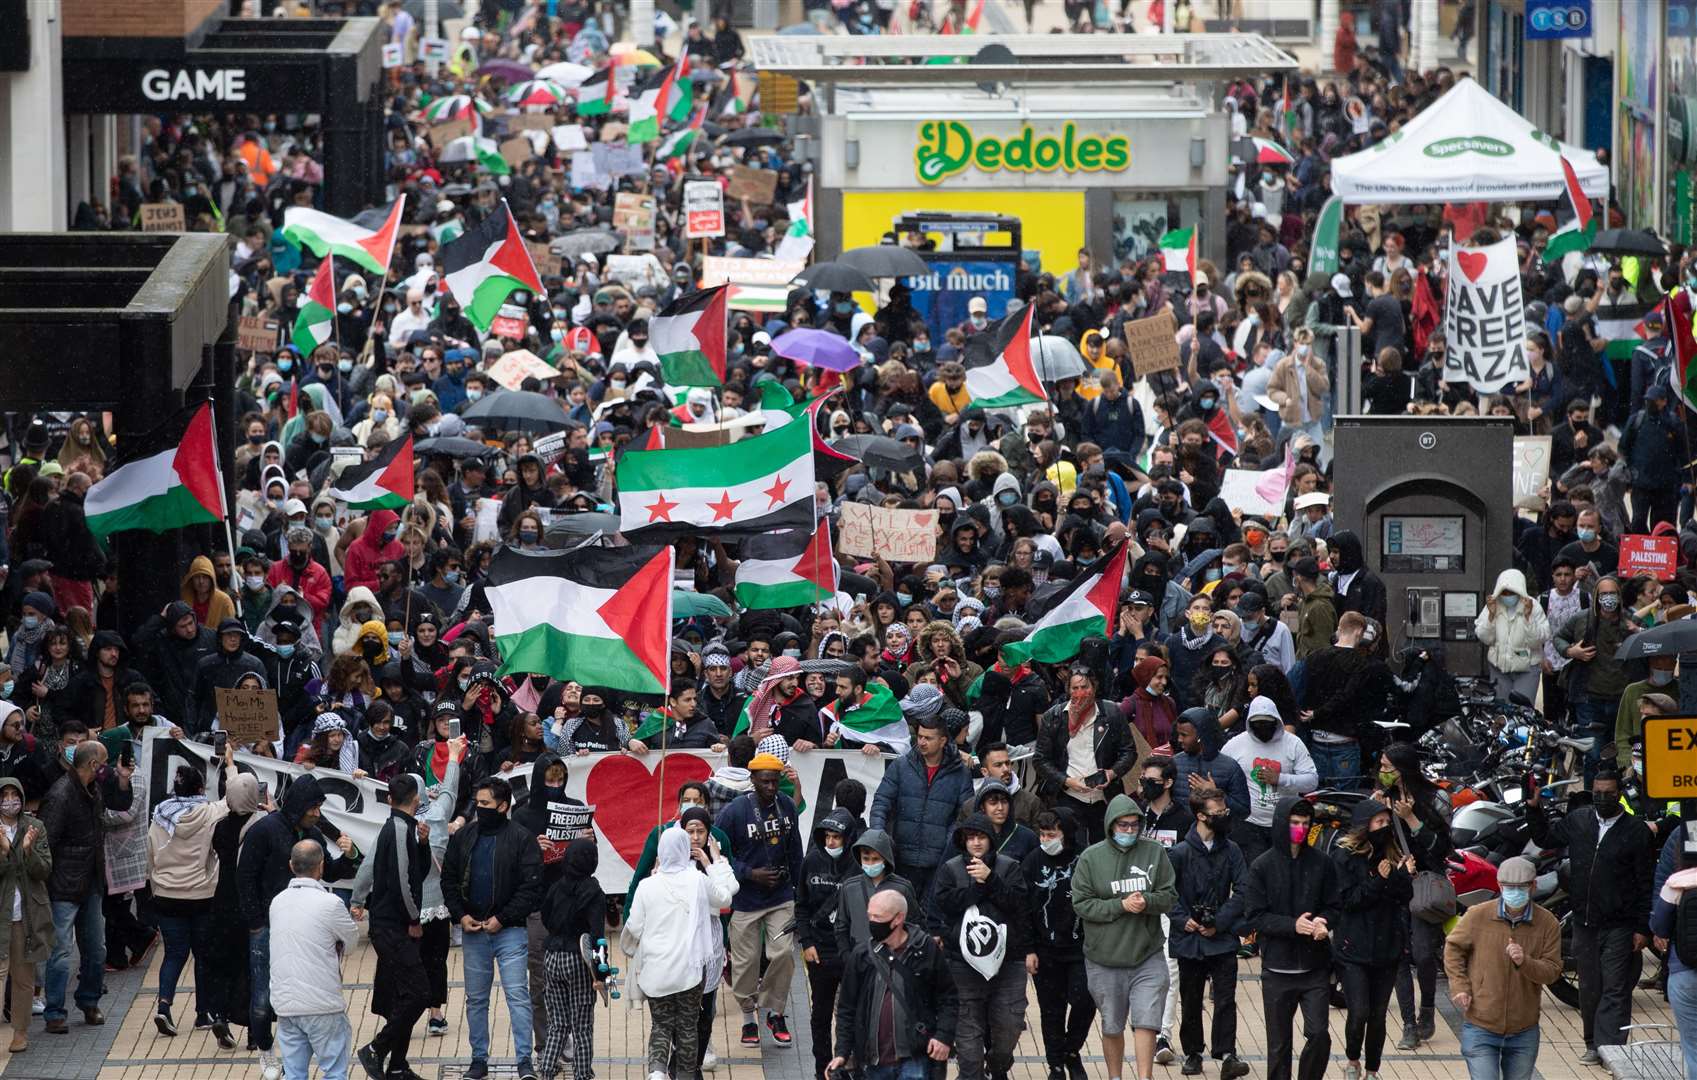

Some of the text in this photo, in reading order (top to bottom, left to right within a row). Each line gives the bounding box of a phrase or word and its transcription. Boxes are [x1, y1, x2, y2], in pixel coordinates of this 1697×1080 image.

[142, 69, 246, 100] GAME
[918, 121, 1128, 181] Dedoles
[1431, 139, 1508, 157] Specsavers
[1355, 183, 1371, 193] The
[1477, 181, 1514, 194] provider
[1518, 181, 1528, 192] of
[946, 269, 1010, 291] much
[1450, 275, 1520, 316] SAVE
[1448, 308, 1524, 349] FREE
[1446, 344, 1527, 383] GAZA
[1422, 437, 1433, 445] BT
[1643, 538, 1656, 551] FREE
[1631, 550, 1668, 564] PALESTINE
[437, 702, 456, 711] SOHO
[1673, 775, 1697, 787] BR
[550, 812, 589, 825] FREEDOM
[1111, 877, 1147, 894] PUMA
